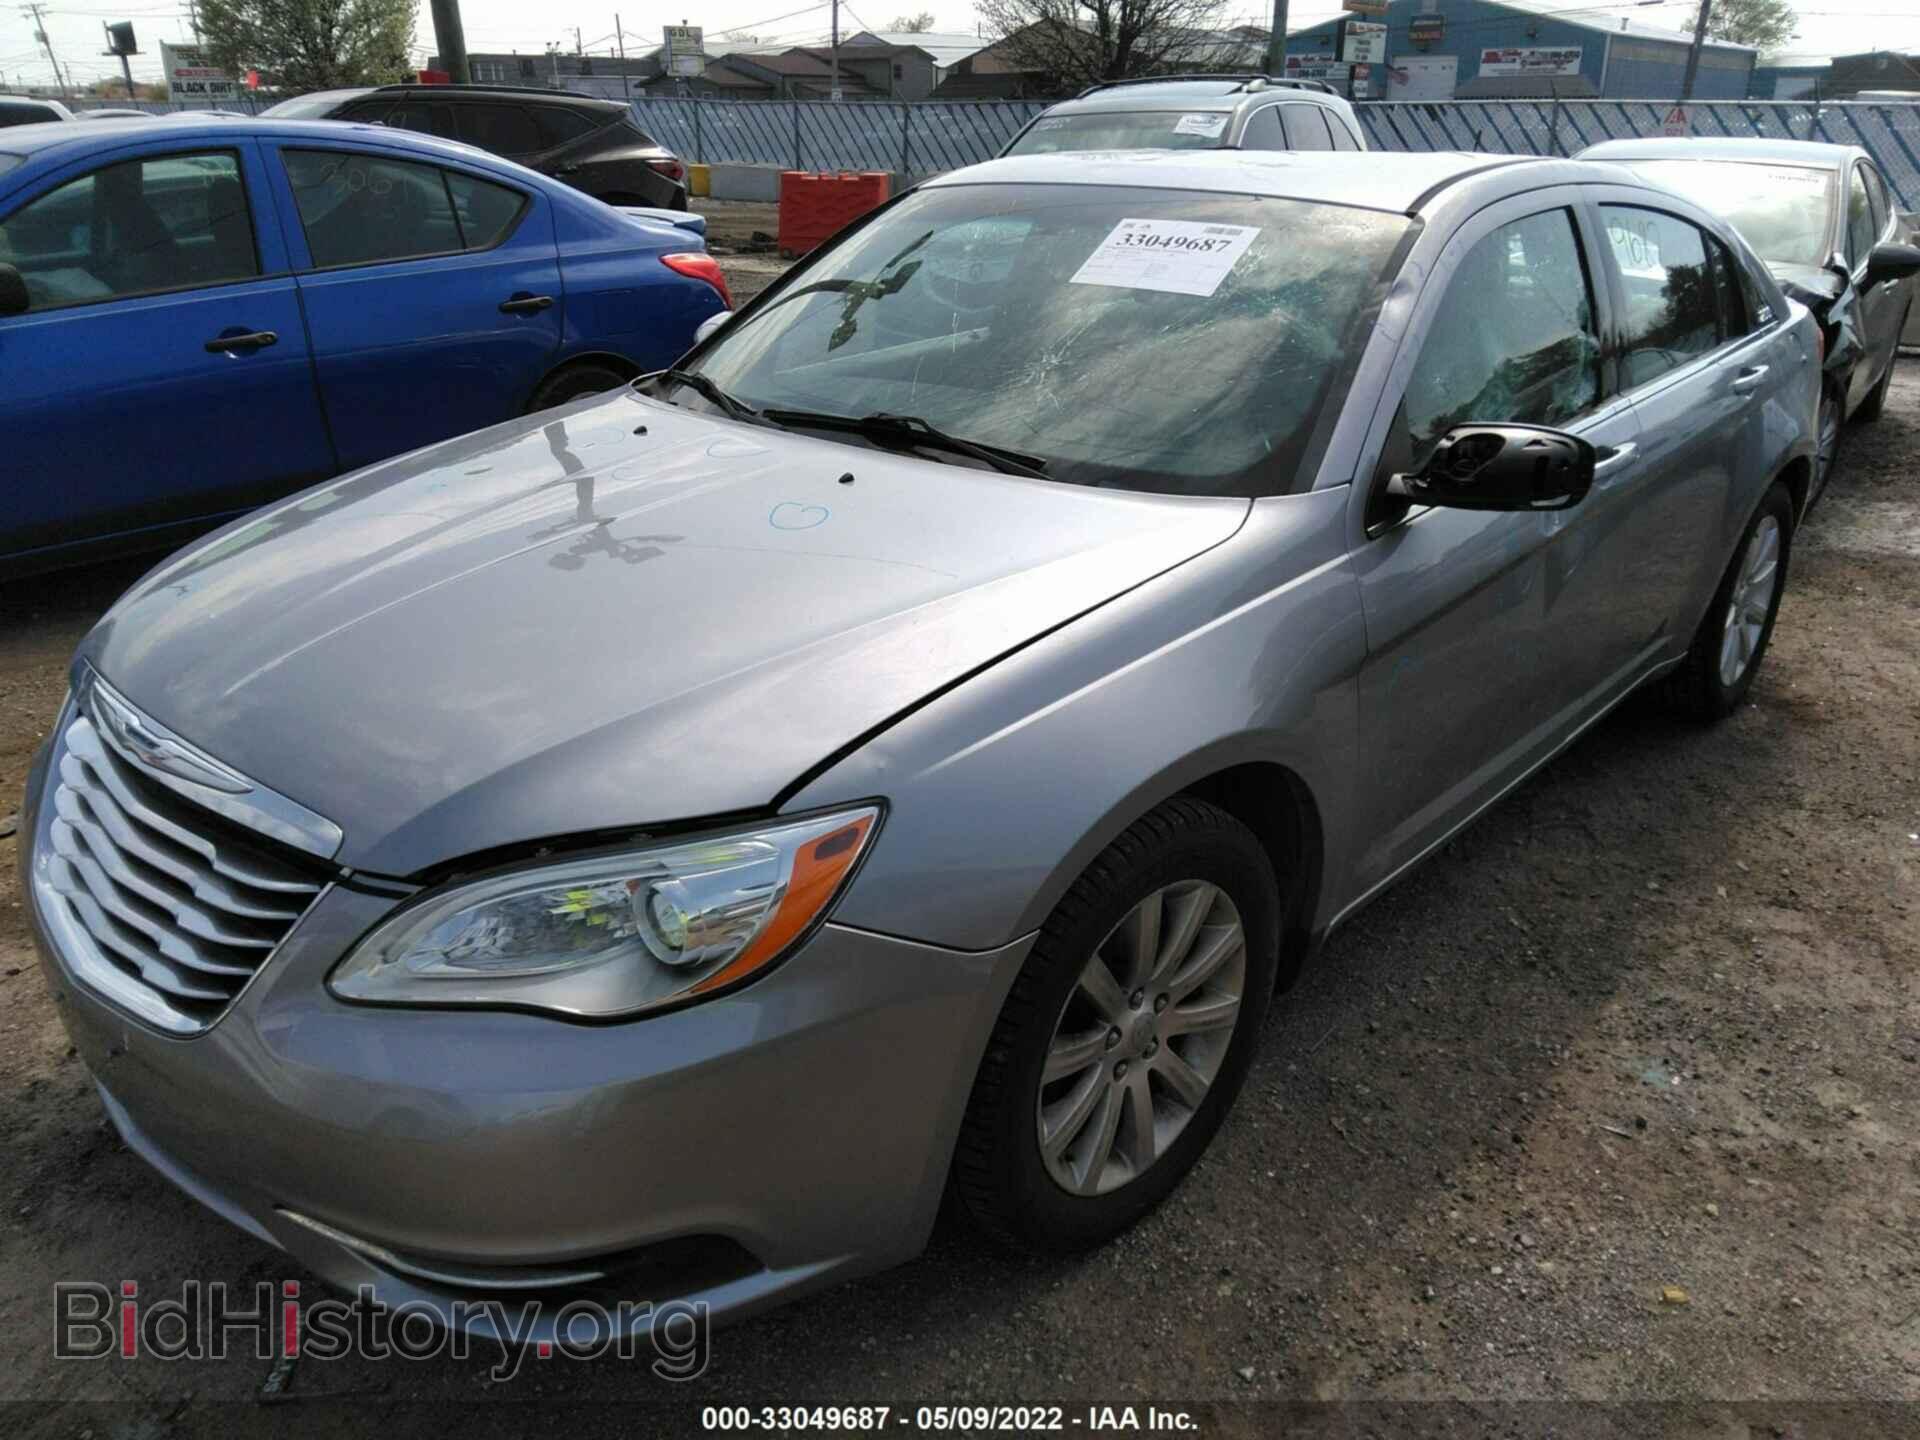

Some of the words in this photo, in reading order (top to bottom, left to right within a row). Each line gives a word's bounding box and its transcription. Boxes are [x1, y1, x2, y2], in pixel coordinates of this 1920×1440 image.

[172, 82, 206, 93] BLACK
[209, 82, 232, 93] DIRT
[1116, 233, 1233, 253] 33049687
